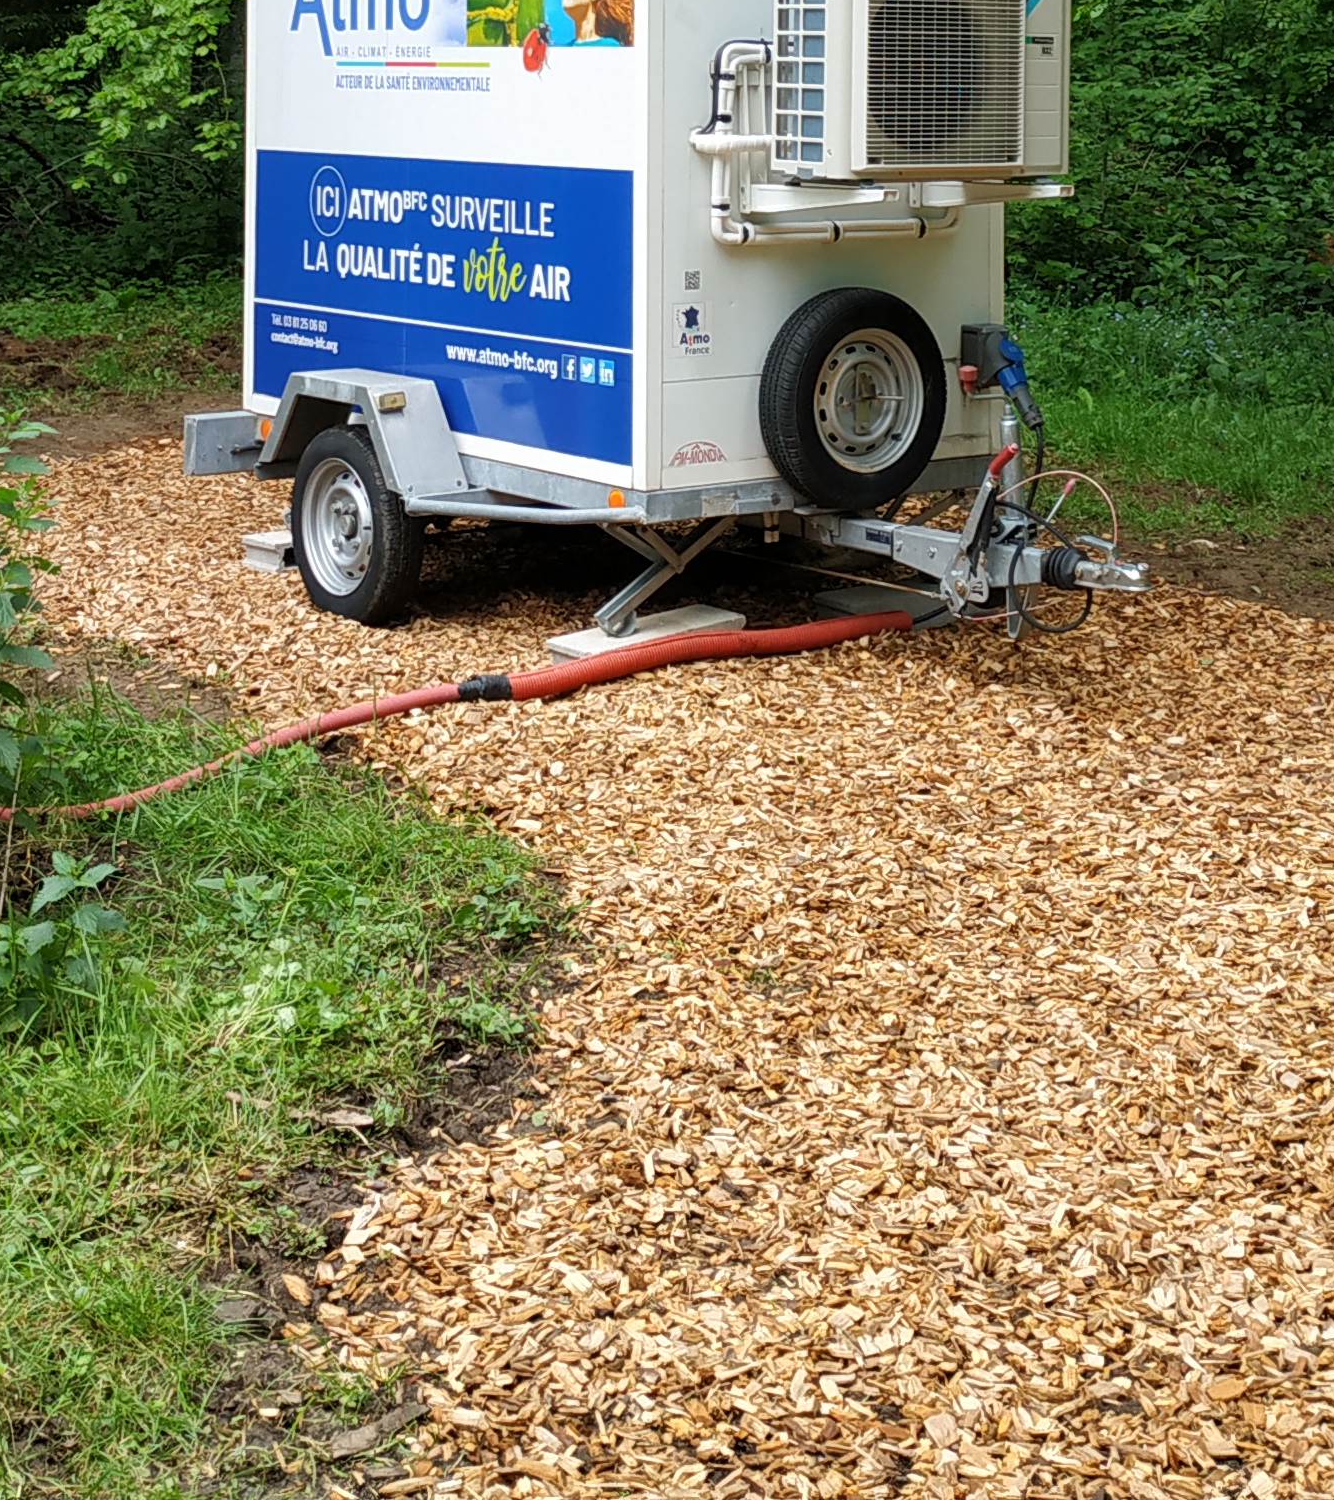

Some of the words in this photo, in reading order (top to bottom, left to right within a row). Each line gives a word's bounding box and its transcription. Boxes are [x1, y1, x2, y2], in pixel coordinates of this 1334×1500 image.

[335, 46, 350, 58] AIR
[357, 46, 387, 58] CLIMAT
[395, 45, 432, 58] ÉNERGIE
[335, 74, 363, 90] ACTEUR
[364, 75, 374, 90] DE
[374, 75, 385, 90] LA
[386, 72, 411, 91] SANTÉ
[412, 75, 491, 92] ENVIRONNEMENTALE
[316, 185, 340, 218] ICI
[430, 193, 555, 237] SURVEILLE
[303, 239, 330, 273] LA
[336, 242, 423, 284] QUALITÉ
[427, 251, 456, 288] DE
[462, 236, 527, 302] votre
[529, 263, 571, 302] AIR
[300, 317, 309, 330] 25
[679, 332, 710, 346] Atmo
[685, 346, 710, 355] France
[445, 344, 558, 380] www.atmo-bfc.org
